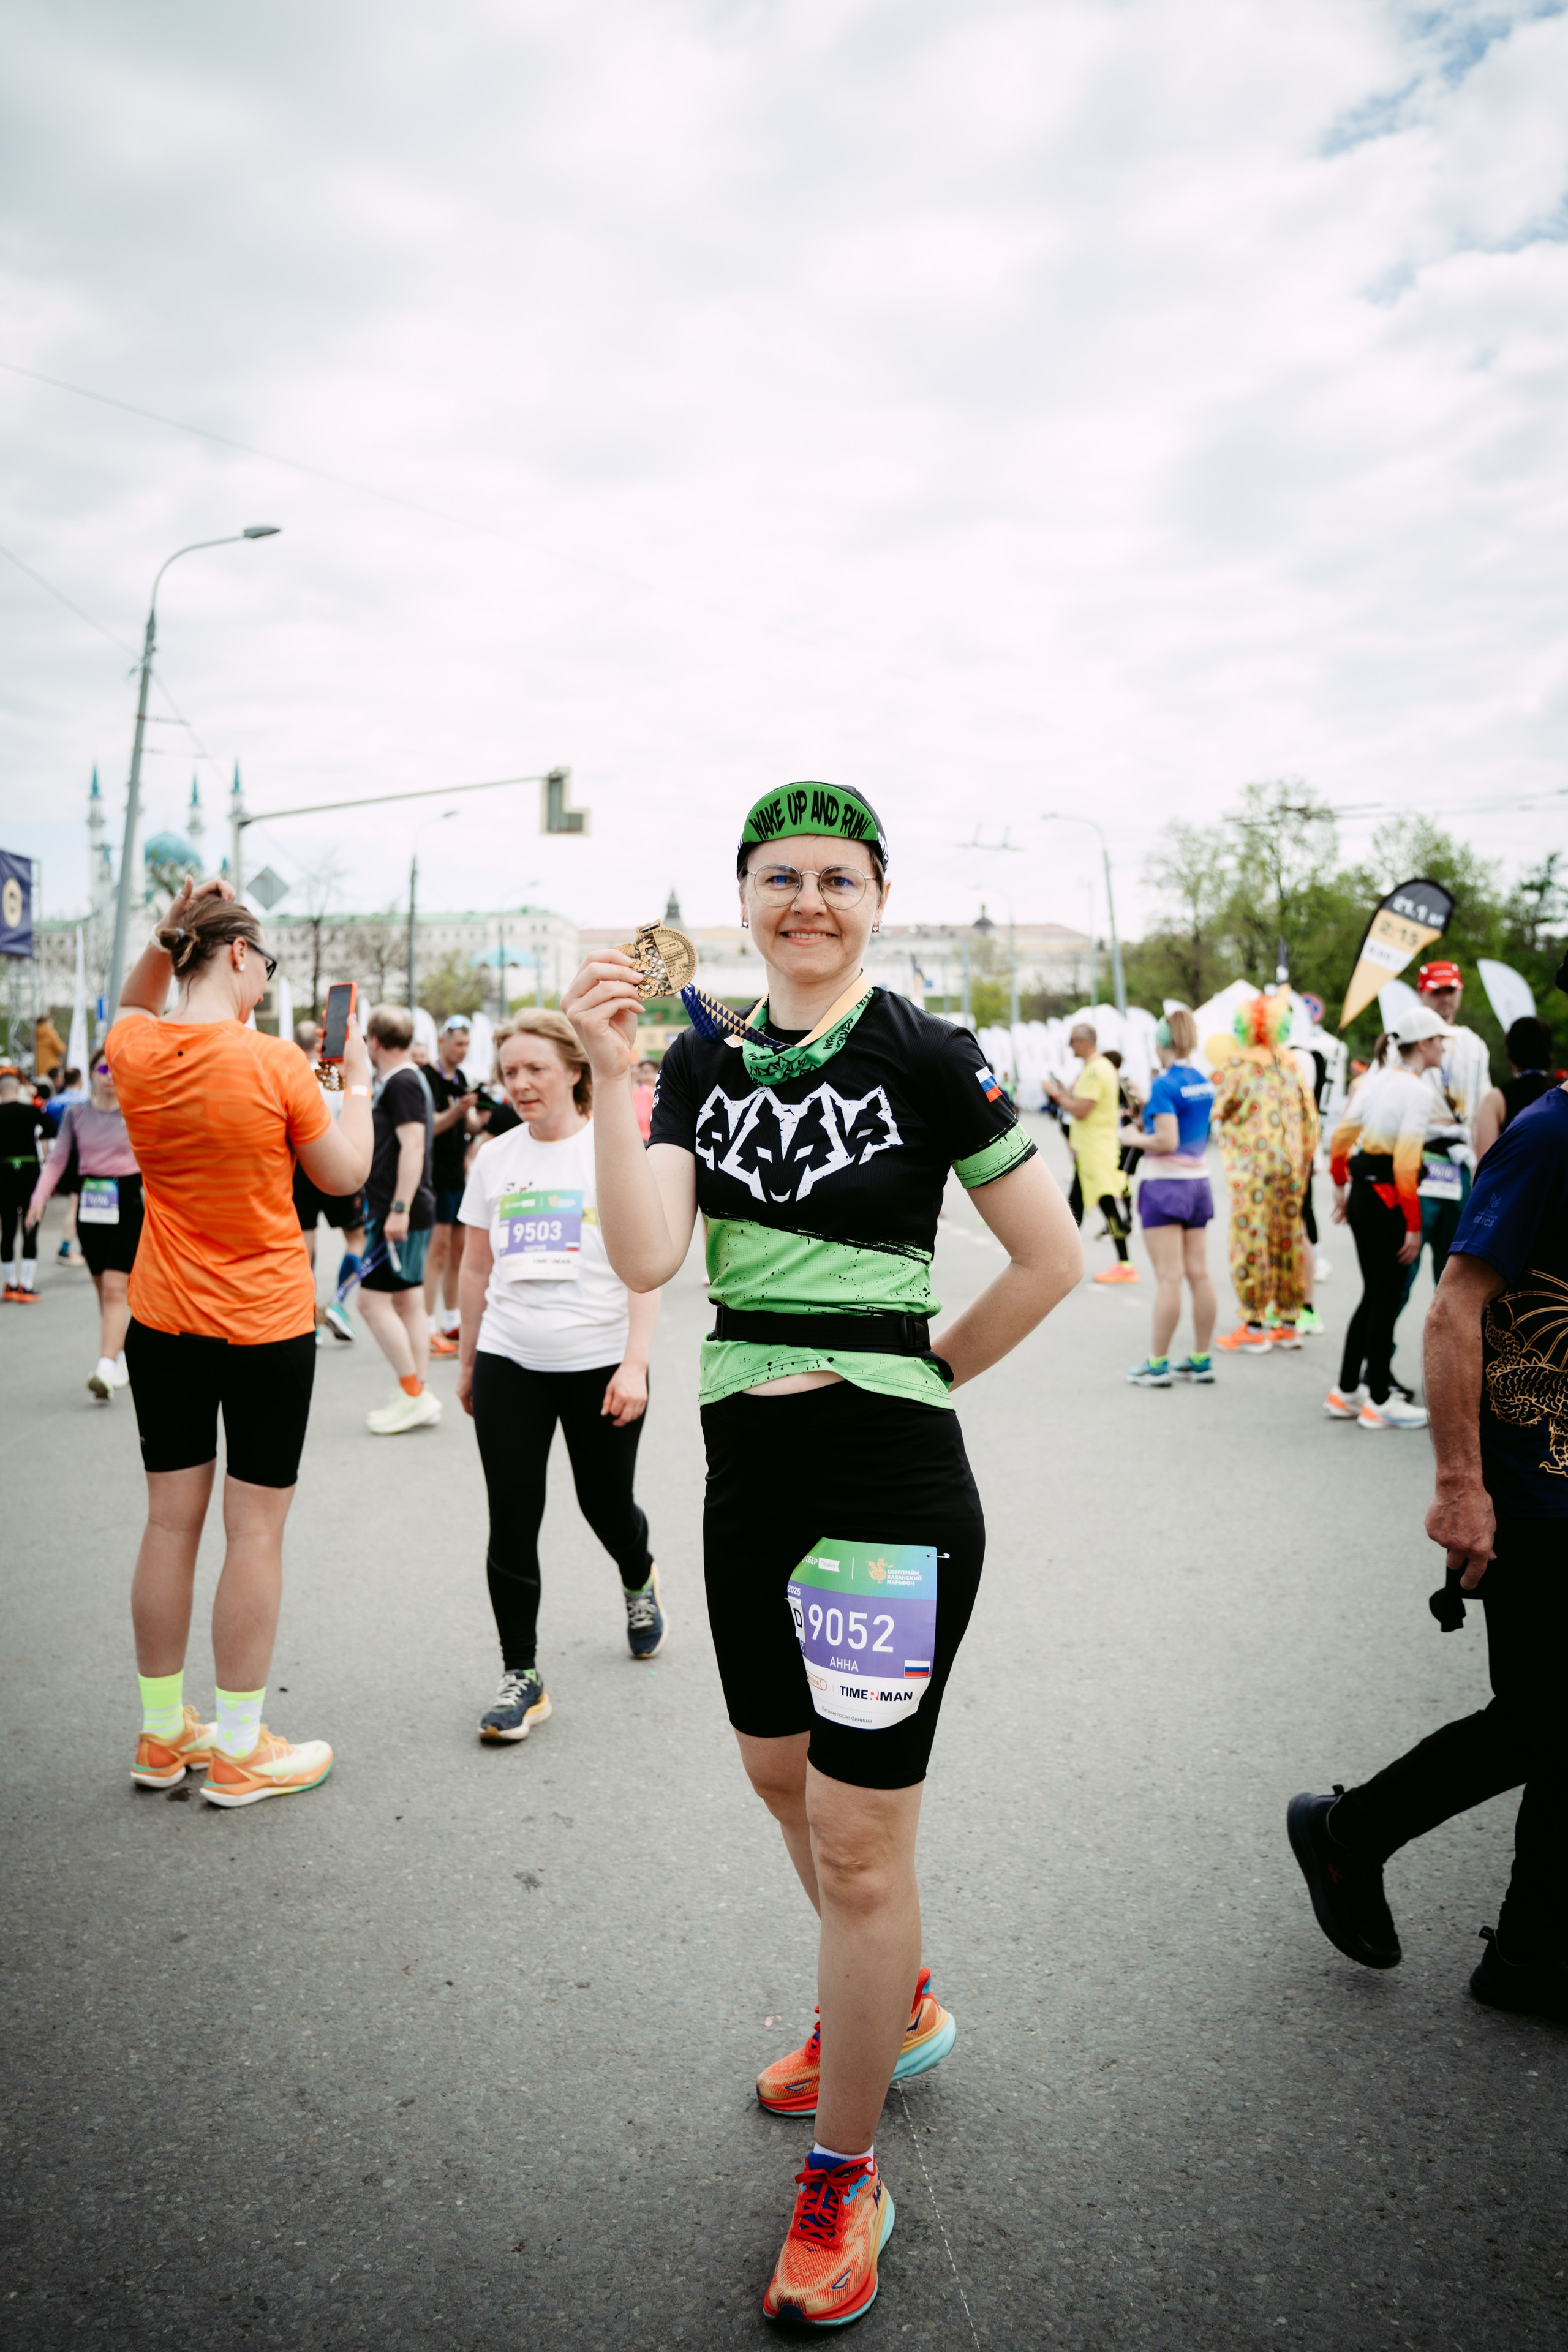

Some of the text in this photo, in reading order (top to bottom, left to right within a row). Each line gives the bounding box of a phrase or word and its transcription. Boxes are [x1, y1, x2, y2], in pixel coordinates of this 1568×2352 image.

[748, 797, 785, 841] WAKE
[787, 790, 807, 826] UP
[810, 790, 839, 827] AND
[513, 1220, 562, 1243] 9503
[805, 1555, 818, 1565] СБЕР
[787, 1585, 801, 1596] 2025
[809, 1604, 894, 1653] 9052
[829, 1656, 859, 1672] АННА
[821, 1706, 837, 1716] Питание
